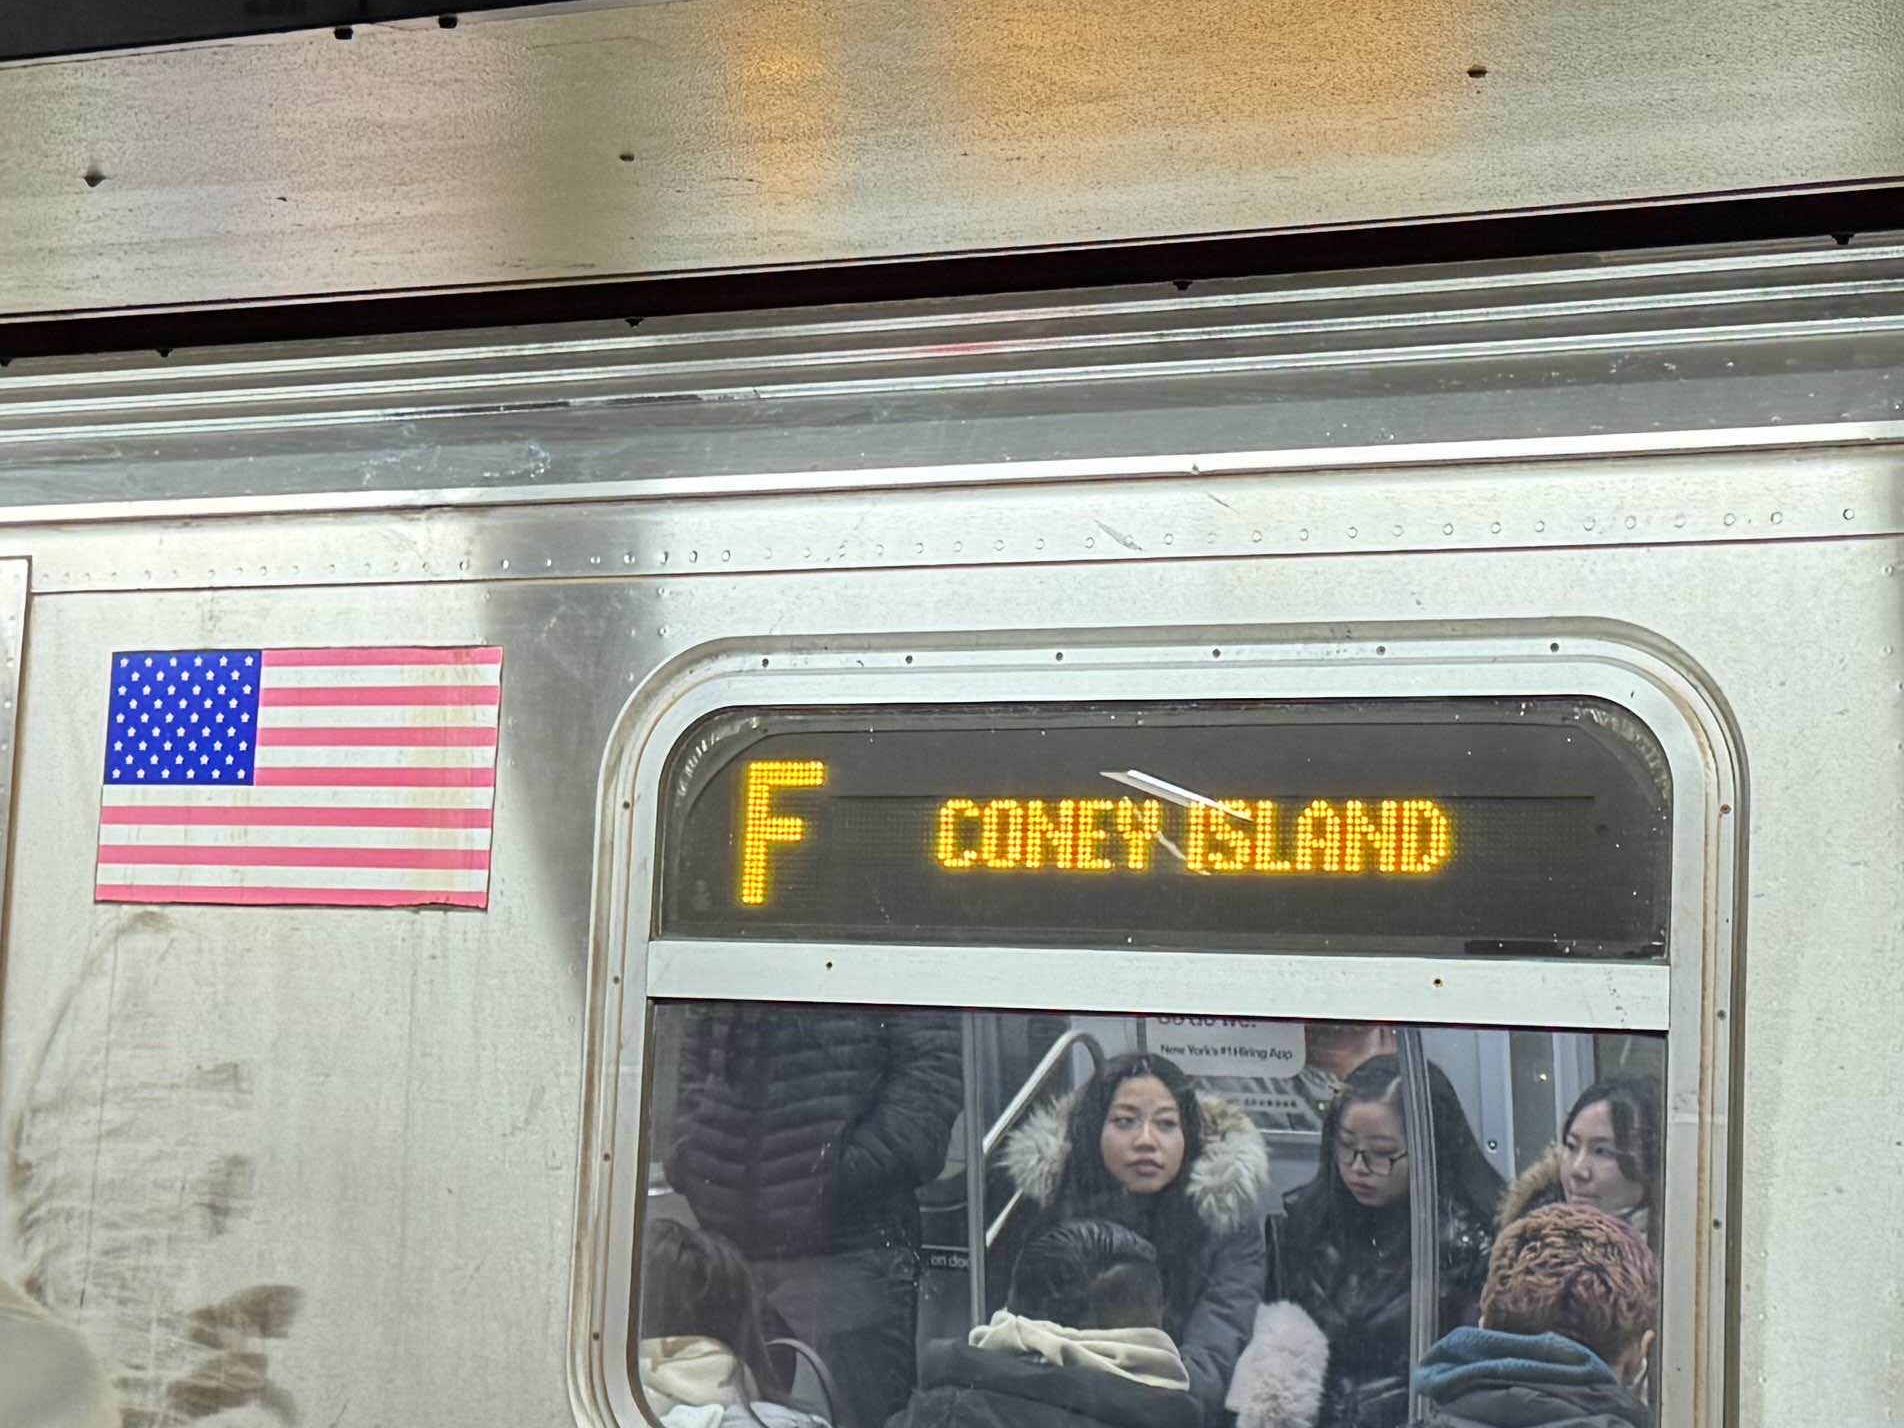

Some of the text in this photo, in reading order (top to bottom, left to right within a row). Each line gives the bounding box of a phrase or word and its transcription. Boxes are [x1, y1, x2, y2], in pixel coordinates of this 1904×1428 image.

[740, 759, 827, 906] F
[937, 797, 1452, 874] CONEY ISLAND
[1160, 1043, 1185, 1055] New
[1187, 1044, 1218, 1057] York's
[1269, 1048, 1293, 1061] App
[948, 1253, 969, 1268] do
